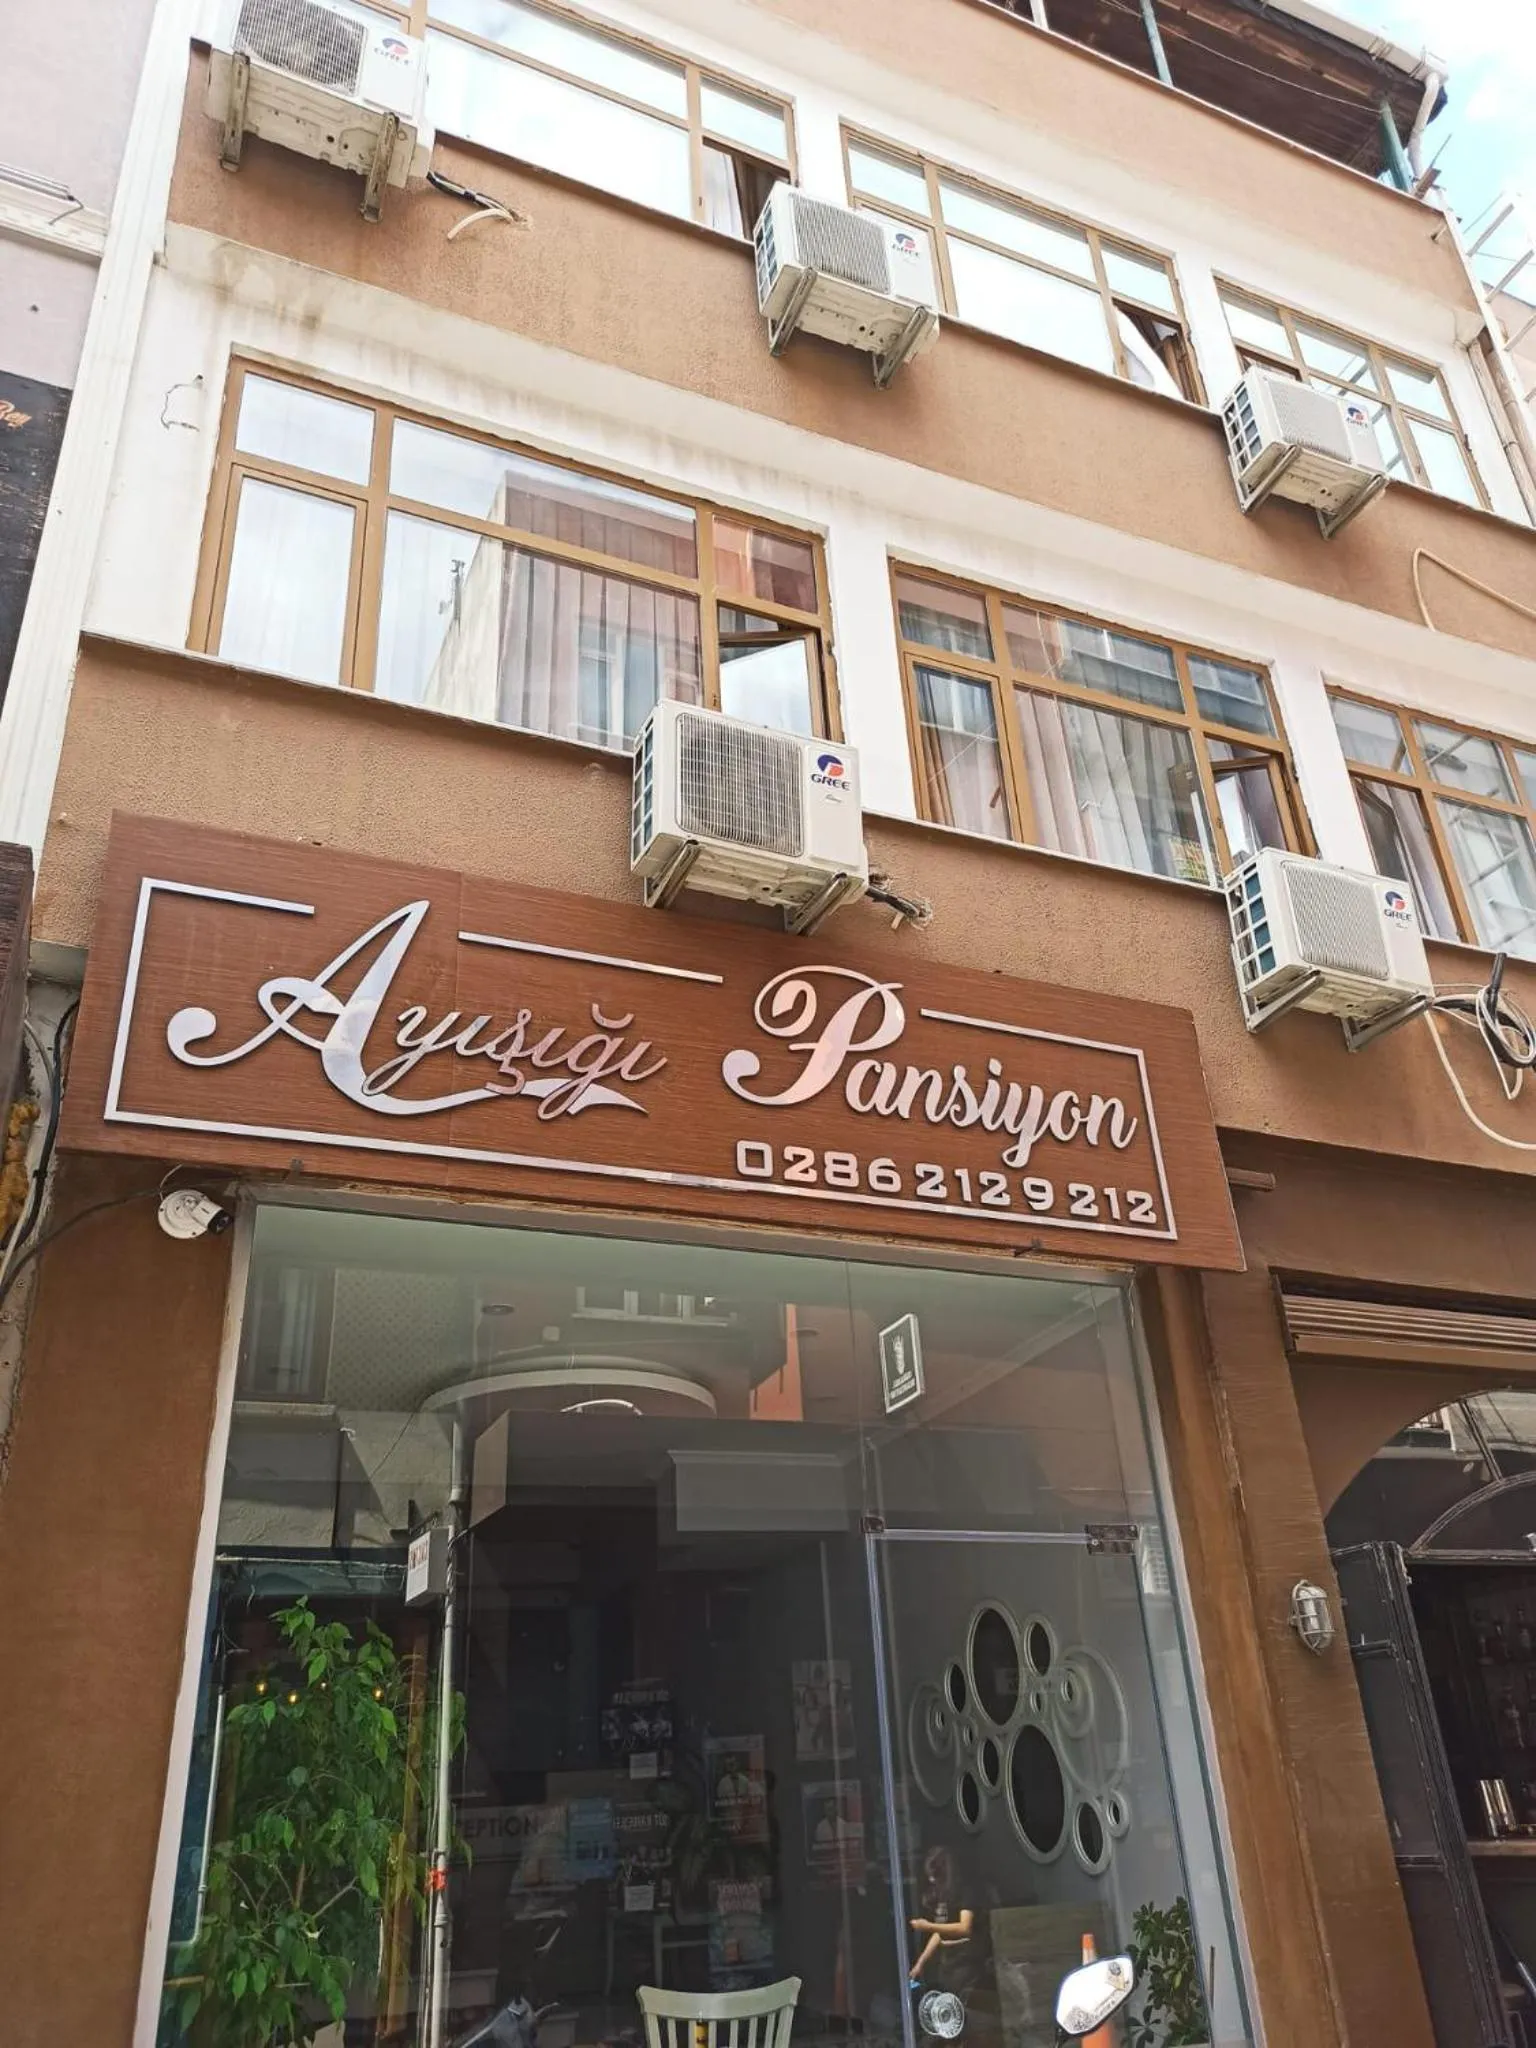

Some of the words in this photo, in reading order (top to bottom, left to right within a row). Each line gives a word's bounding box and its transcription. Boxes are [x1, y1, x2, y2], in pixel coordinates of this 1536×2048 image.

[811, 773, 852, 792] GREE
[1384, 908, 1412, 921] GREE
[722, 964, 1138, 1169] Pansiyon
